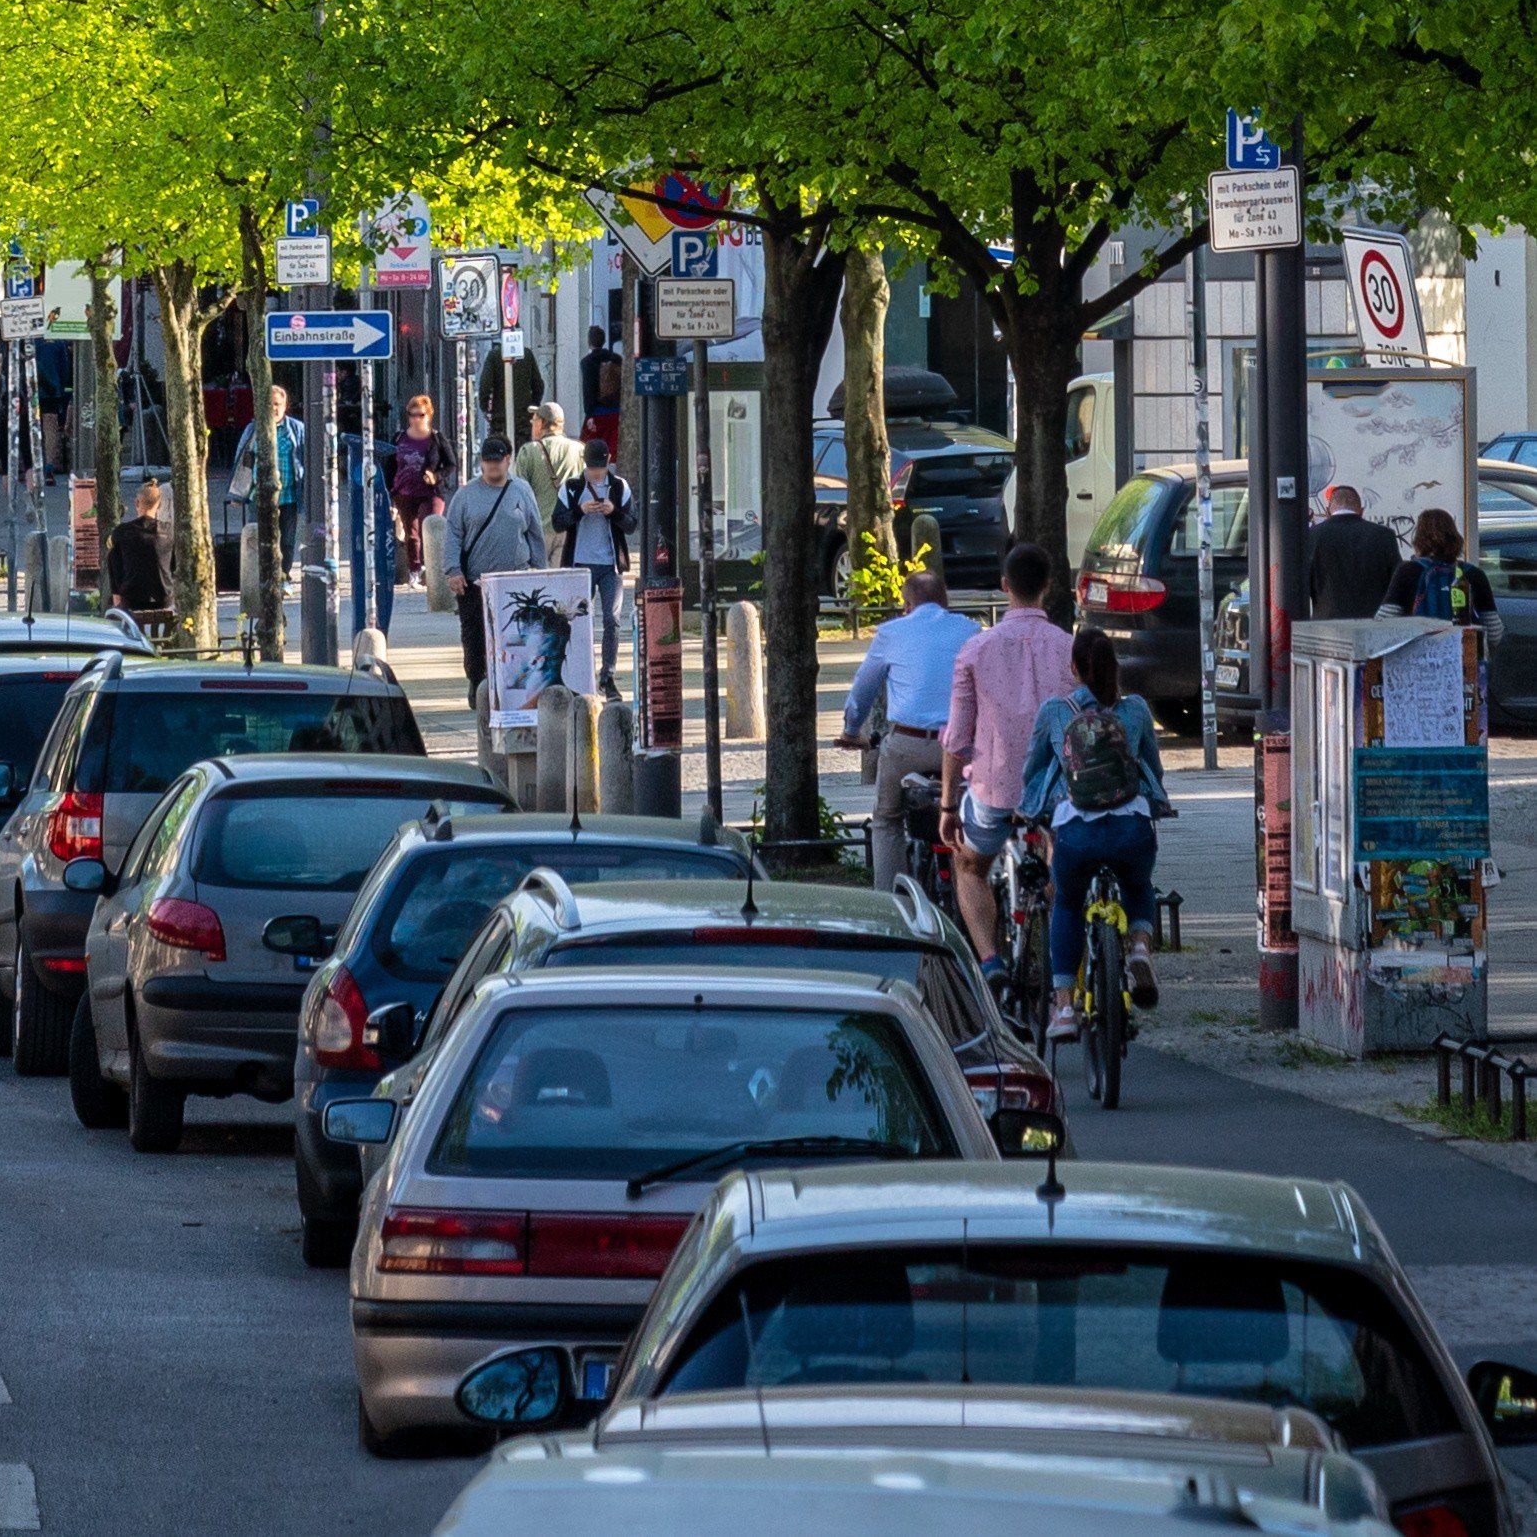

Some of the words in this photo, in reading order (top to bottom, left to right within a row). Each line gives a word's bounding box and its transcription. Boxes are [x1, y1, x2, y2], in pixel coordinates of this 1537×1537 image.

[1217, 184, 1229, 194] mit
[1232, 181, 1271, 193] Parkschein
[1274, 179, 1289, 189] oder
[1215, 195, 1294, 209] Bewohnerparkausweis
[291, 204, 309, 233] P
[1233, 212, 1244, 223] für
[1247, 212, 1265, 222] Zone
[1267, 210, 1277, 220] 43
[679, 237, 704, 272] P
[458, 279, 480, 300] 30
[677, 287, 711, 295] Parkschein
[713, 287, 727, 295] oder
[1368, 273, 1395, 315] 30
[661, 298, 730, 307] Bewohnerparkausweis
[274, 330, 355, 342] Einbahnstraße
[1377, 343, 1411, 368] ZONE
